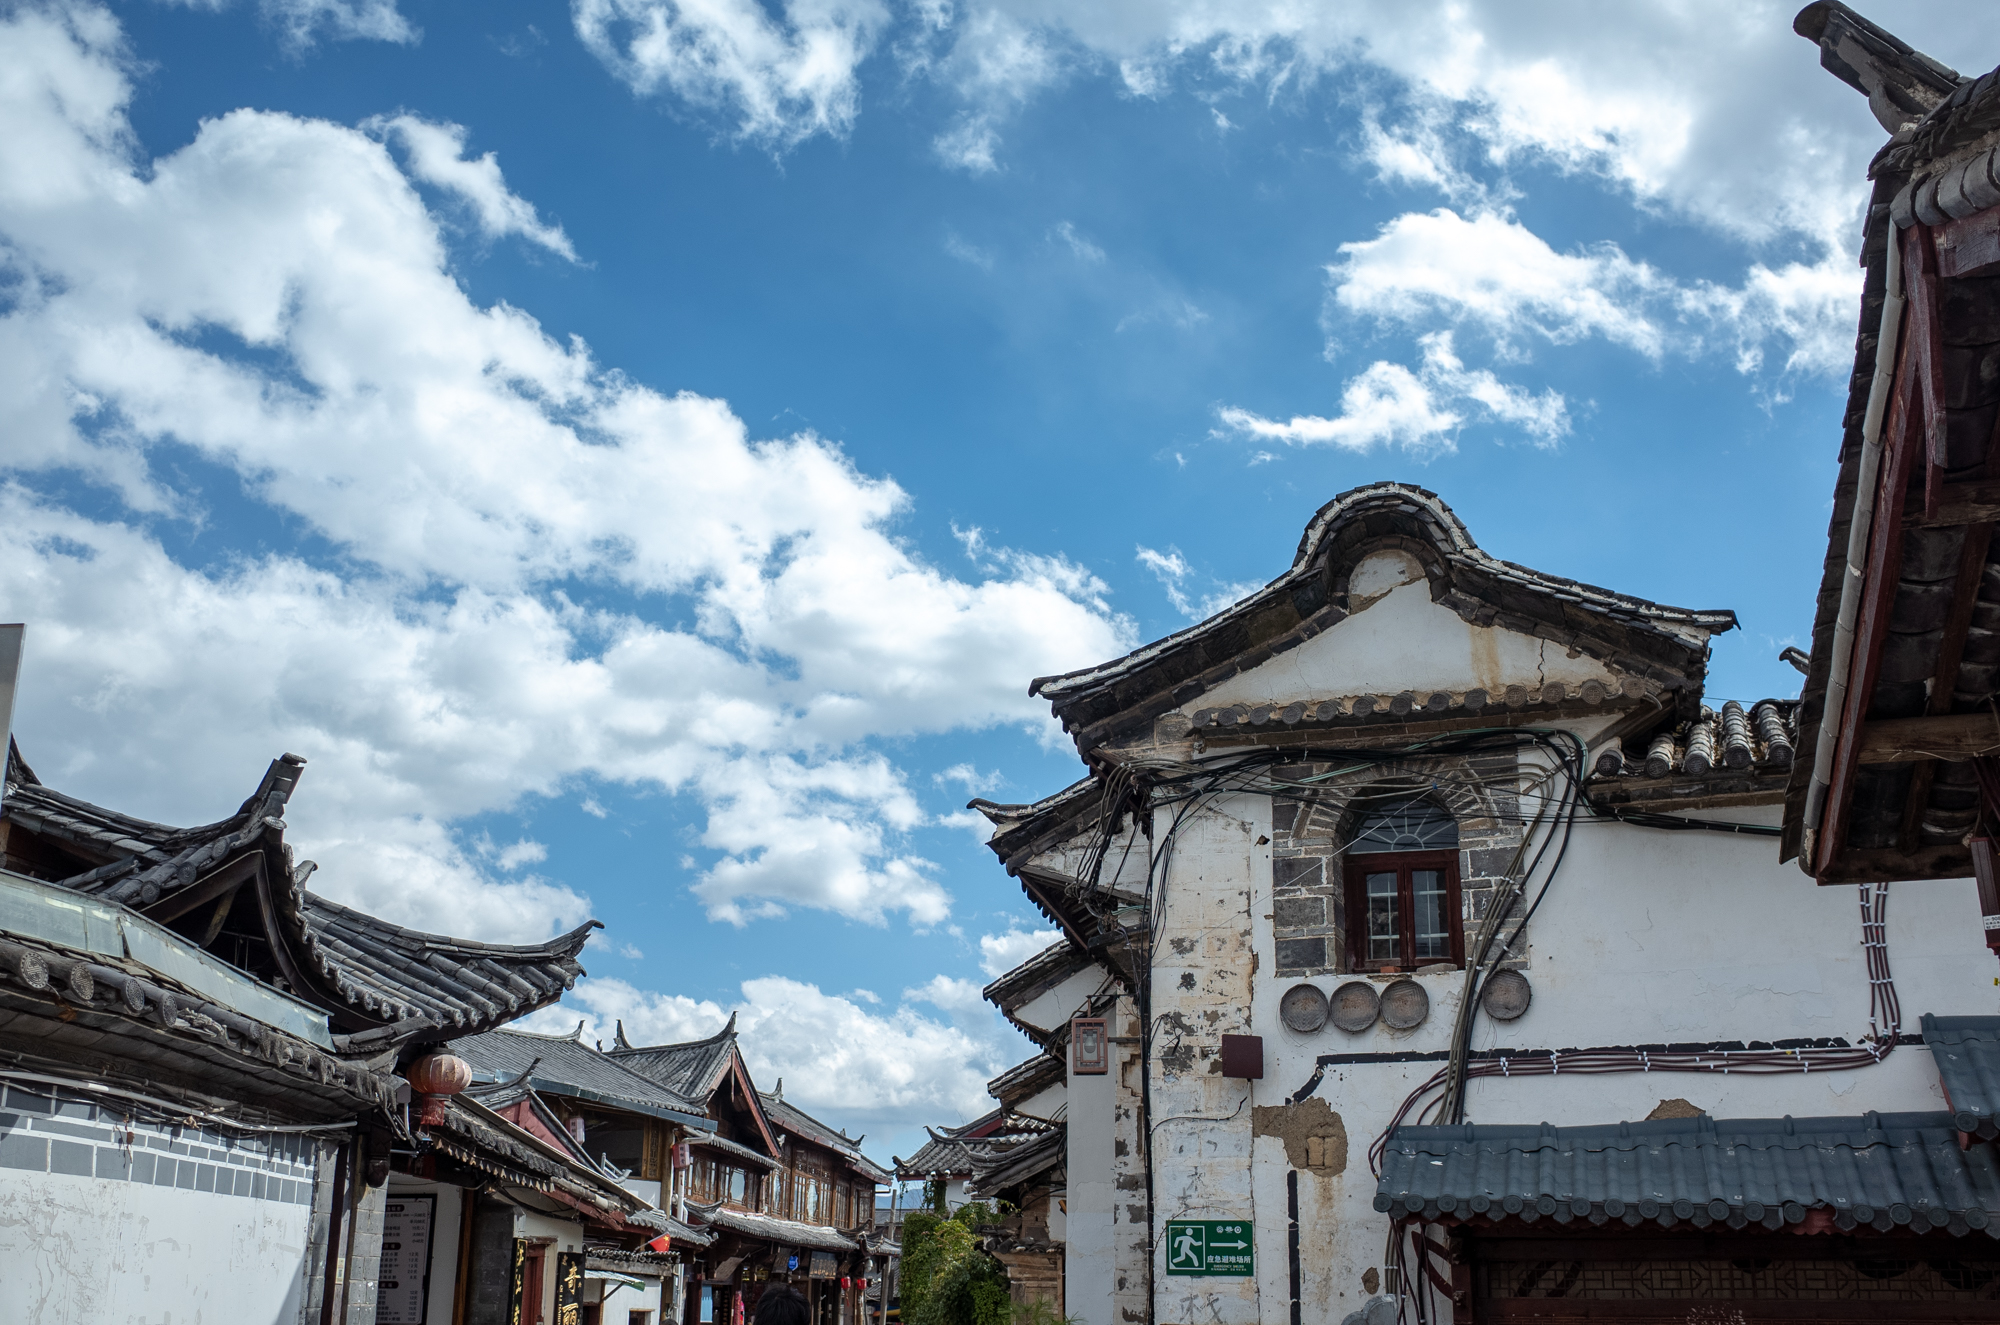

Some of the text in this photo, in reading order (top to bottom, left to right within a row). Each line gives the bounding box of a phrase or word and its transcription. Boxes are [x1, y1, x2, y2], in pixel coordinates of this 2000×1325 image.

[1207, 1255, 1251, 1264] 应急避难场所
